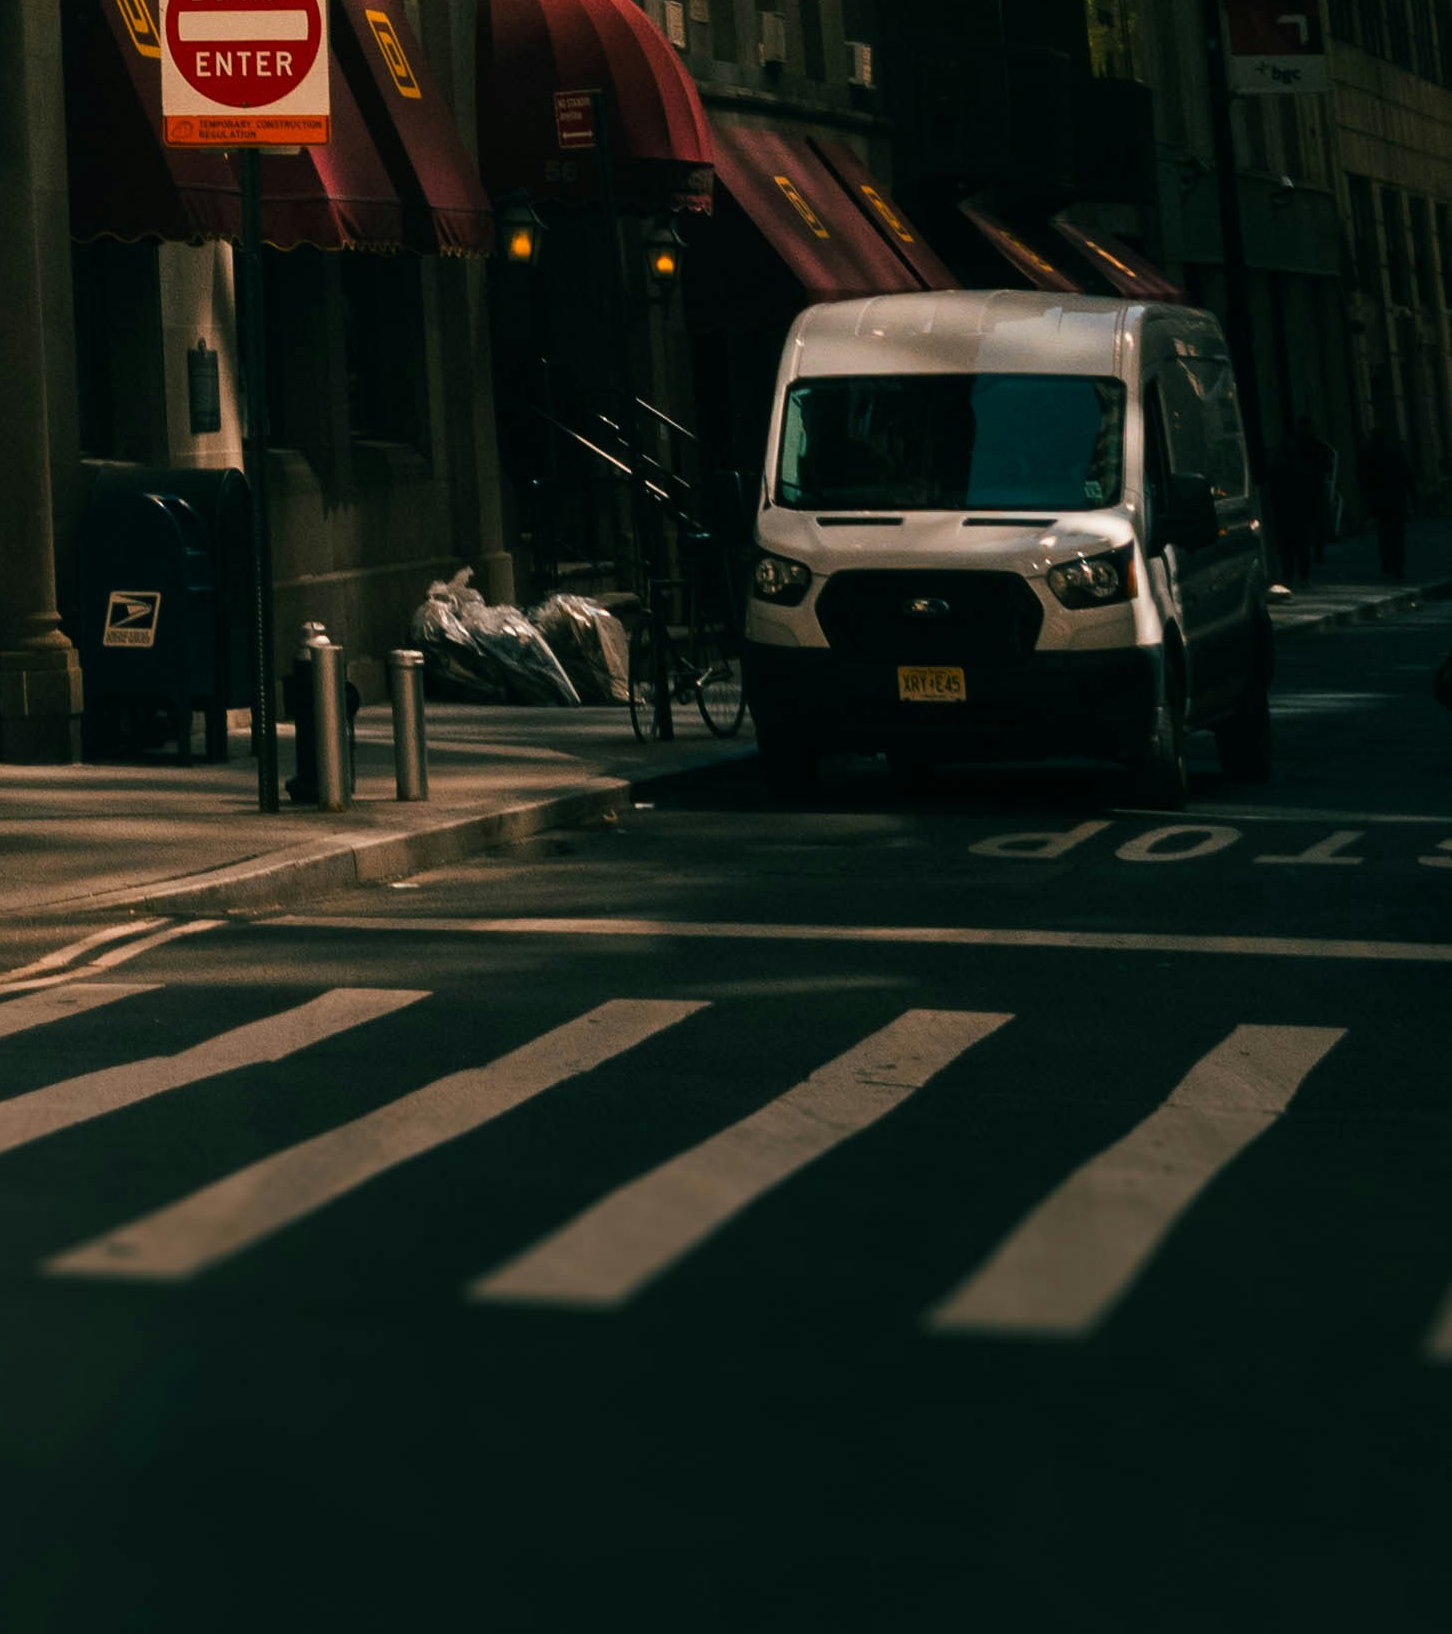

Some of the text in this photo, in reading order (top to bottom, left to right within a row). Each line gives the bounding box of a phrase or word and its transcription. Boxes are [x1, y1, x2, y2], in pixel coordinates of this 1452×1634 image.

[195, 50, 294, 78] ENTER
[199, 119, 322, 131] TEMPORARY CONSTRUCTION
